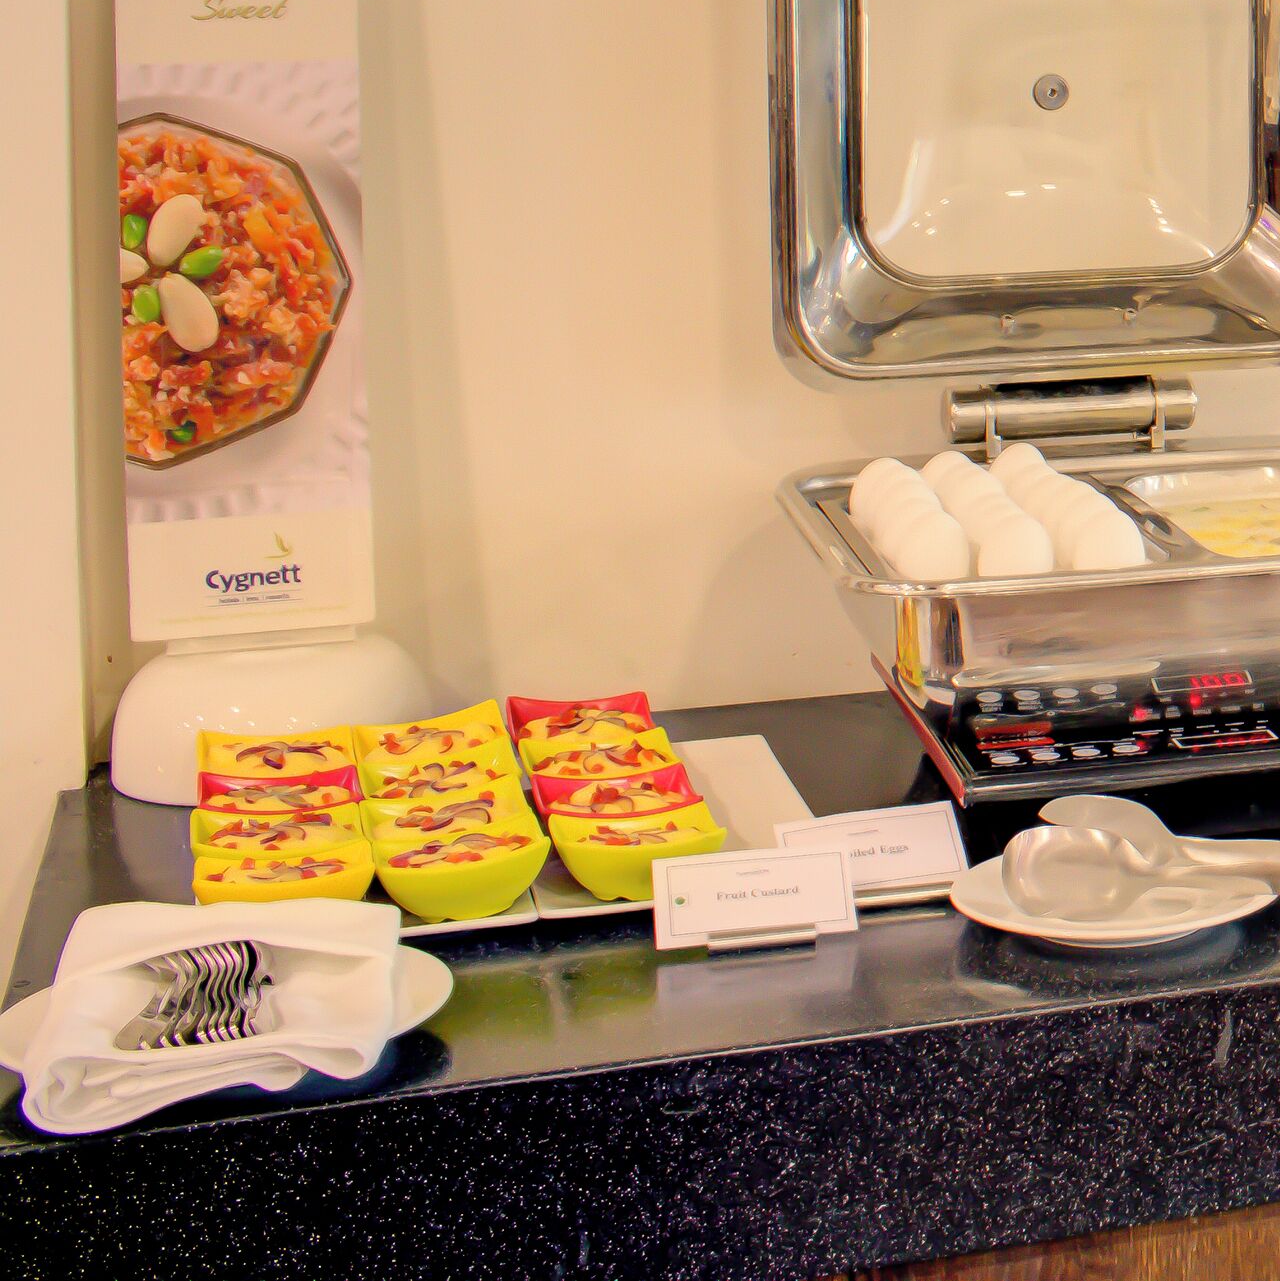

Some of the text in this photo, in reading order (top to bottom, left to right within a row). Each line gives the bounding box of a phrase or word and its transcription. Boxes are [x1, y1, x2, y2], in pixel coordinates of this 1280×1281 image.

[205, 564, 302, 593] Cygnett
[880, 844, 909, 855] Eggs
[716, 885, 799, 901] Fruit Custard
